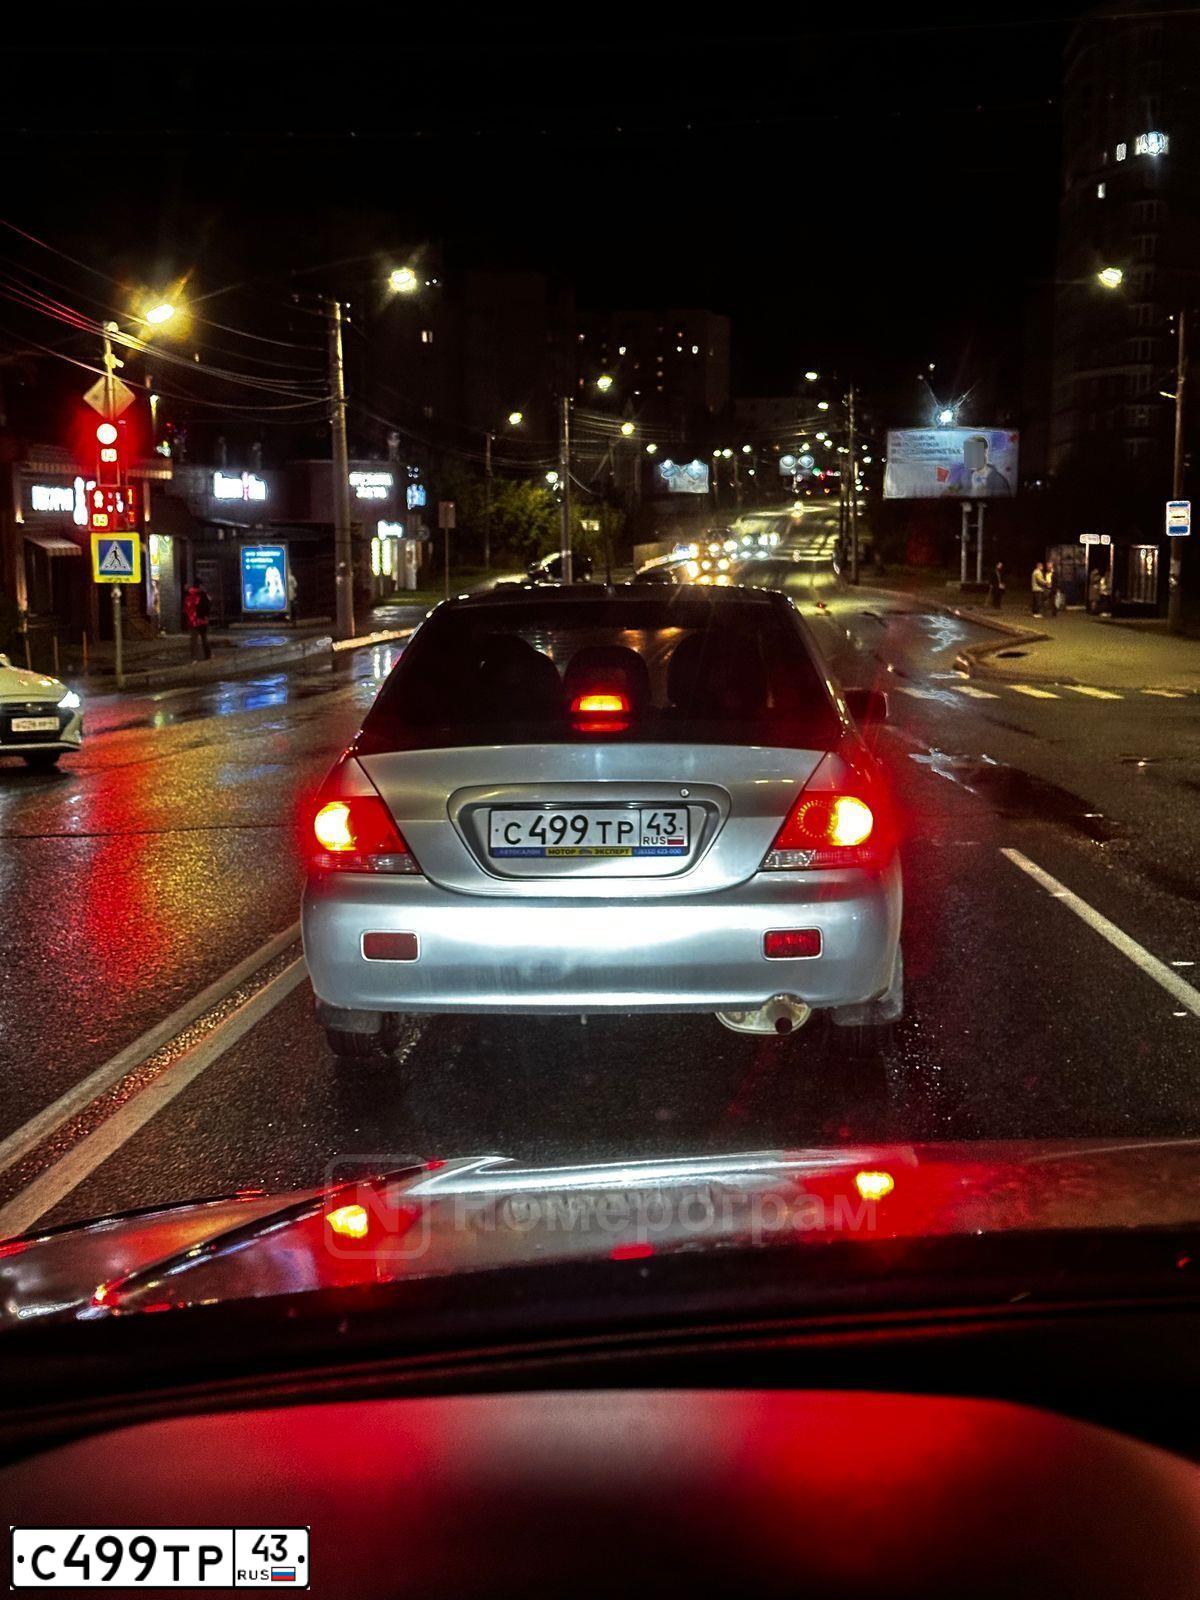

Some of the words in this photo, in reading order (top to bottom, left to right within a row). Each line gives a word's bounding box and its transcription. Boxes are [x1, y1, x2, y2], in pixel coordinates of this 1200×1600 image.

[504, 815, 634, 845] С499ТР
[646, 813, 676, 835] 43
[643, 836, 666, 845] RUS
